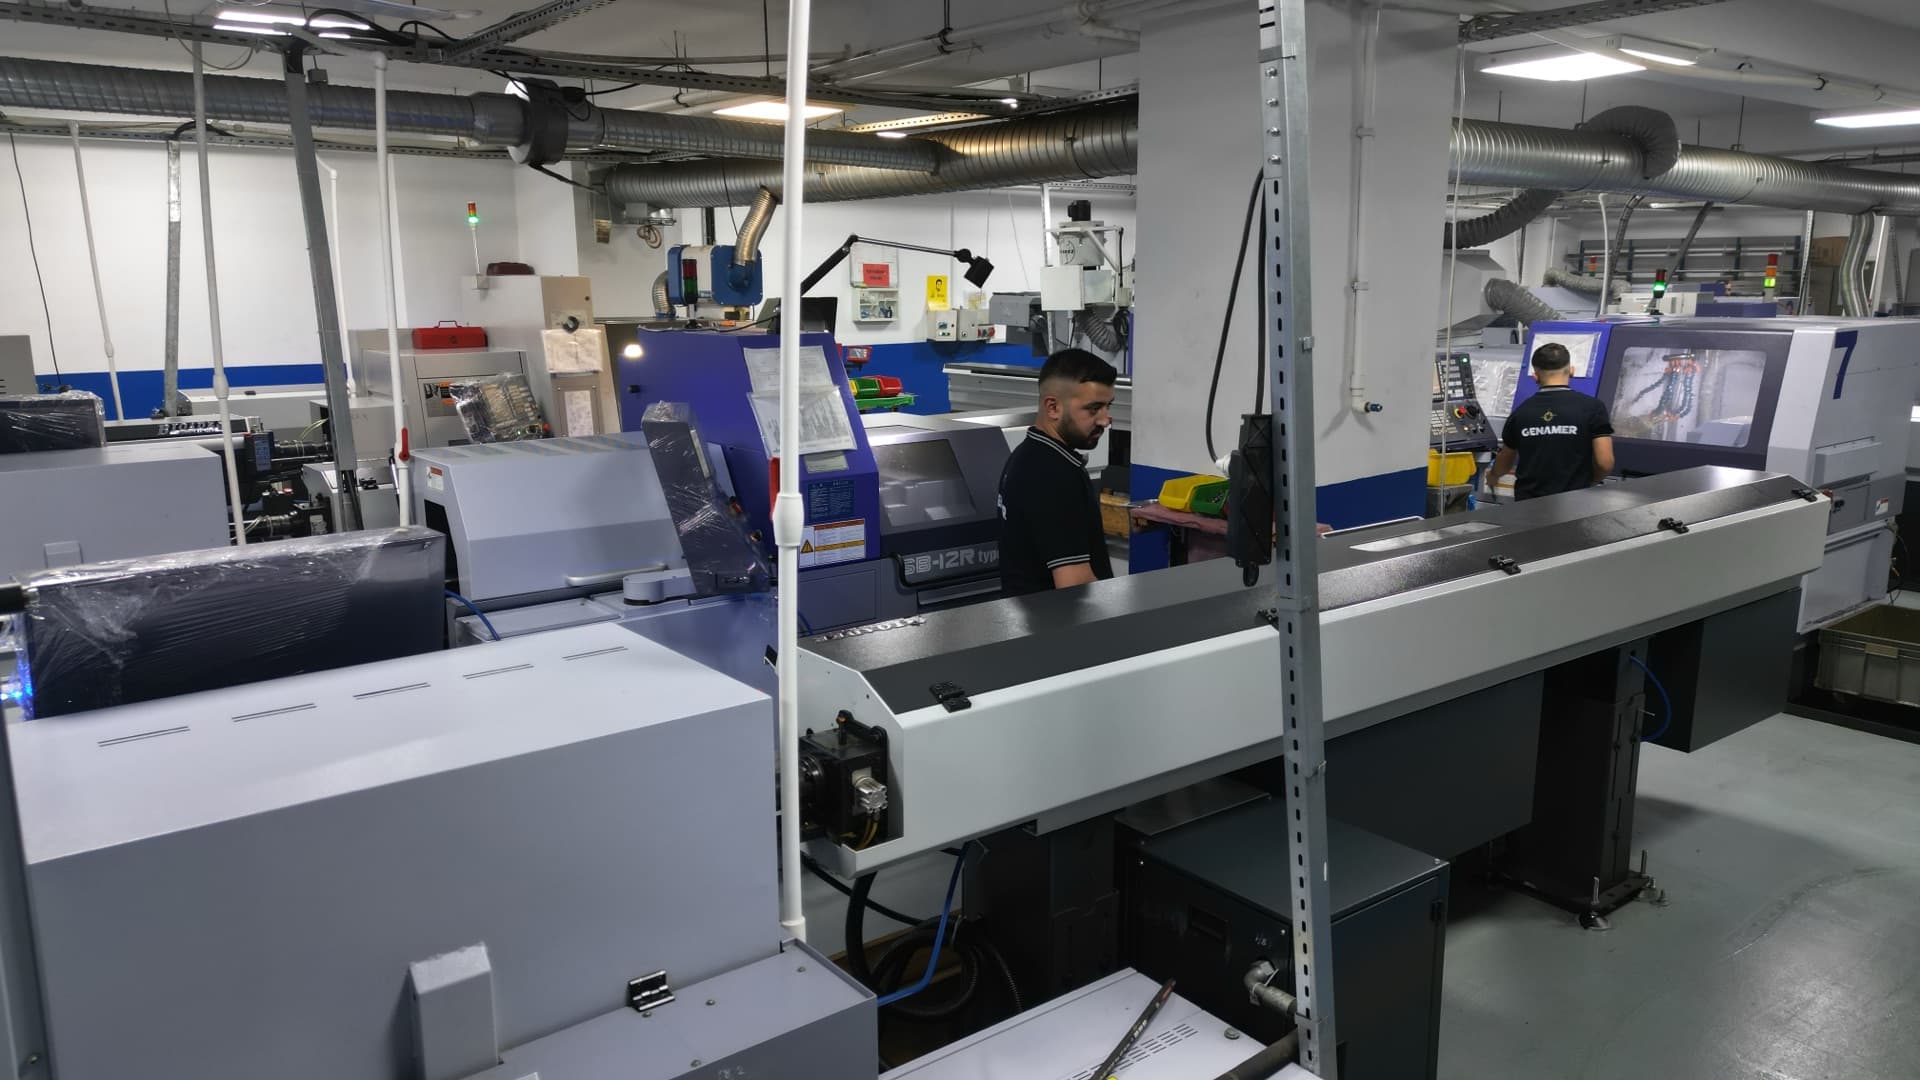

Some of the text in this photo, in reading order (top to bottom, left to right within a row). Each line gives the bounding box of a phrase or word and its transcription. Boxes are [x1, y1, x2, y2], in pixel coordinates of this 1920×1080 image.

[1833, 330, 1858, 400] 7
[1521, 425, 1578, 437] GENAMER
[903, 548, 975, 576] SB-12R
